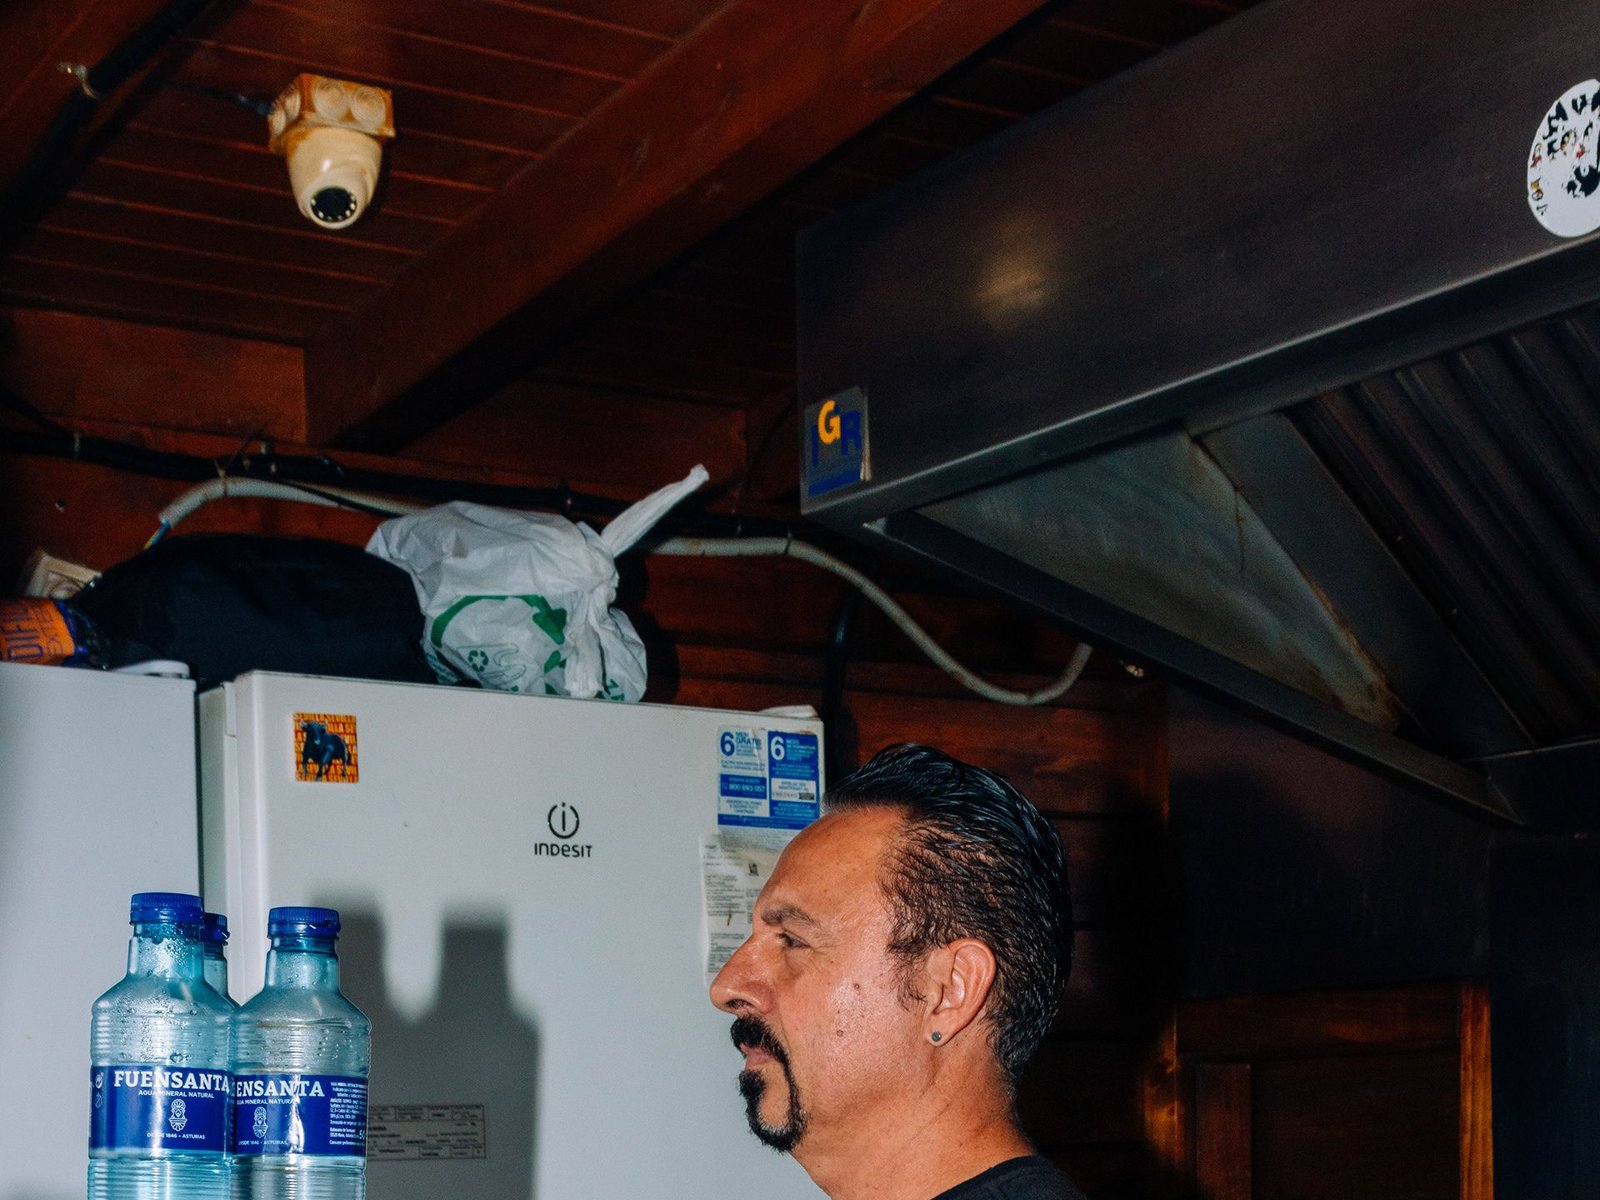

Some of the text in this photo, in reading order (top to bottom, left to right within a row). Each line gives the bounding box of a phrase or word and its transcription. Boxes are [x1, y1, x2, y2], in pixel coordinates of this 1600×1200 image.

[720, 731, 735, 756] 6
[770, 736, 786, 760] 6
[113, 1070, 230, 1093] FUENSANTA
[236, 1080, 325, 1097] ENSANTA
[188, 1091, 215, 1099] NATURAL
